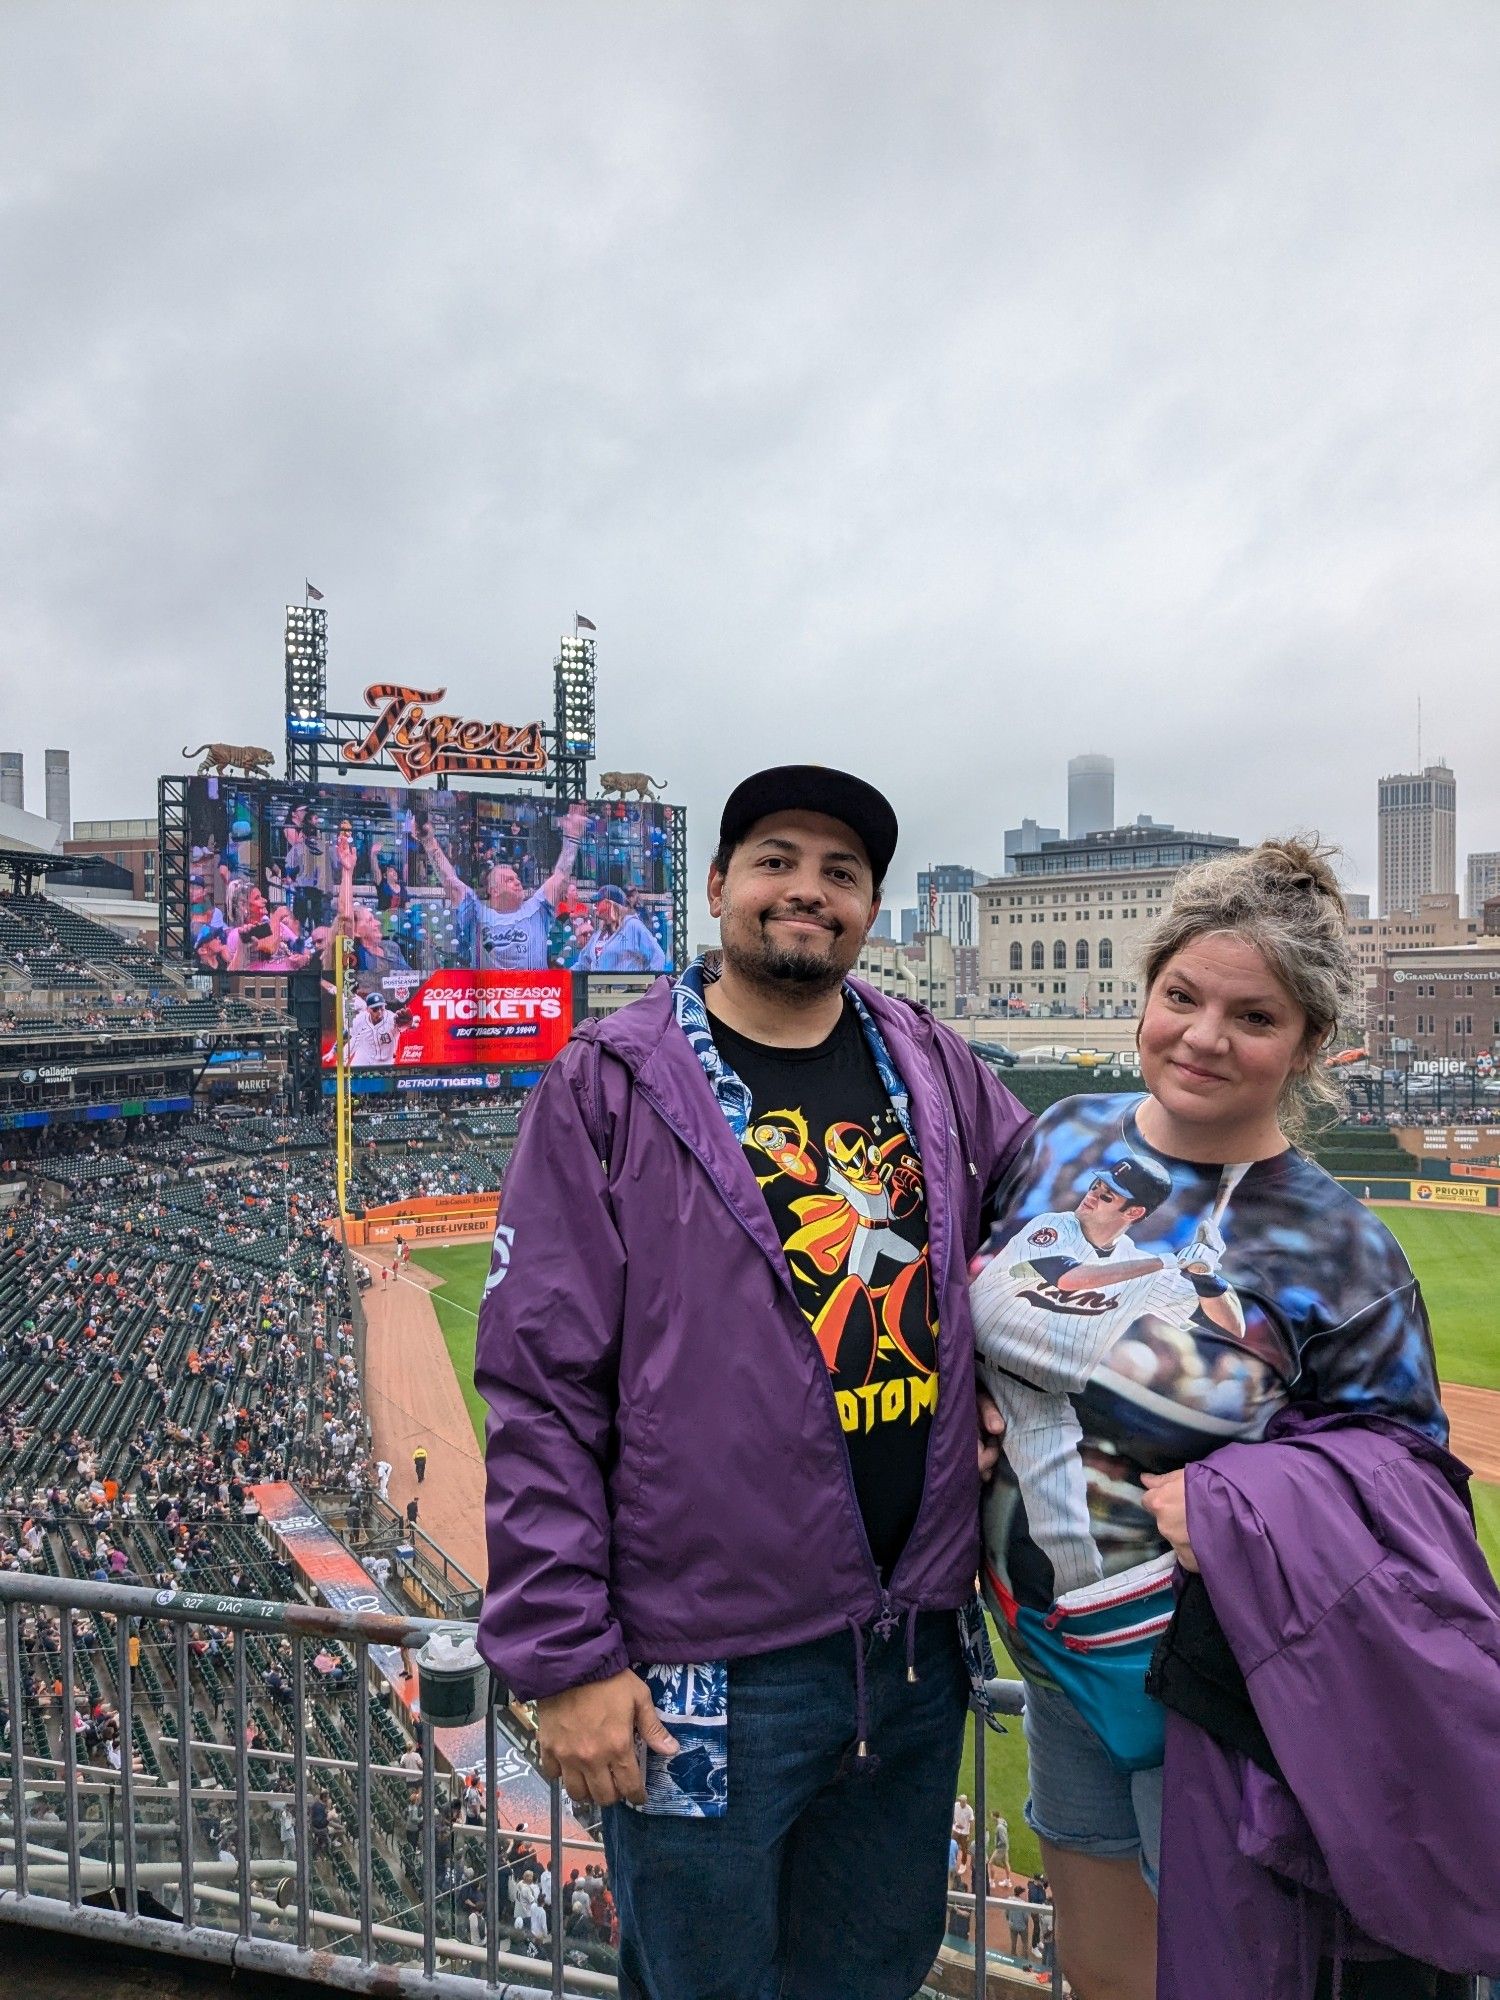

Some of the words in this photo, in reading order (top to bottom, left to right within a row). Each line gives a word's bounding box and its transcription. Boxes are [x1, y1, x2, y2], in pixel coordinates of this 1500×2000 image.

[342, 683, 548, 784] Tigers
[423, 988, 463, 1000] 2024
[464, 986, 562, 999] POSTSEASON
[422, 998, 562, 1020] TICKETS
[456, 1027, 473, 1037] TEXT
[504, 1026, 514, 1035] TO
[38, 1067, 78, 1078] Gallagher
[1413, 1056, 1467, 1077] meijer
[237, 1079, 271, 1091] MARKET
[397, 1079, 442, 1089] DETROIT
[441, 1077, 483, 1087] TIGERS
[1114, 1161, 1132, 1176] T
[1435, 1186, 1480, 1196] PRIORITY
[182, 1597, 204, 1609] 327
[216, 1601, 243, 1614] DAC
[260, 1606, 275, 1617] 12
